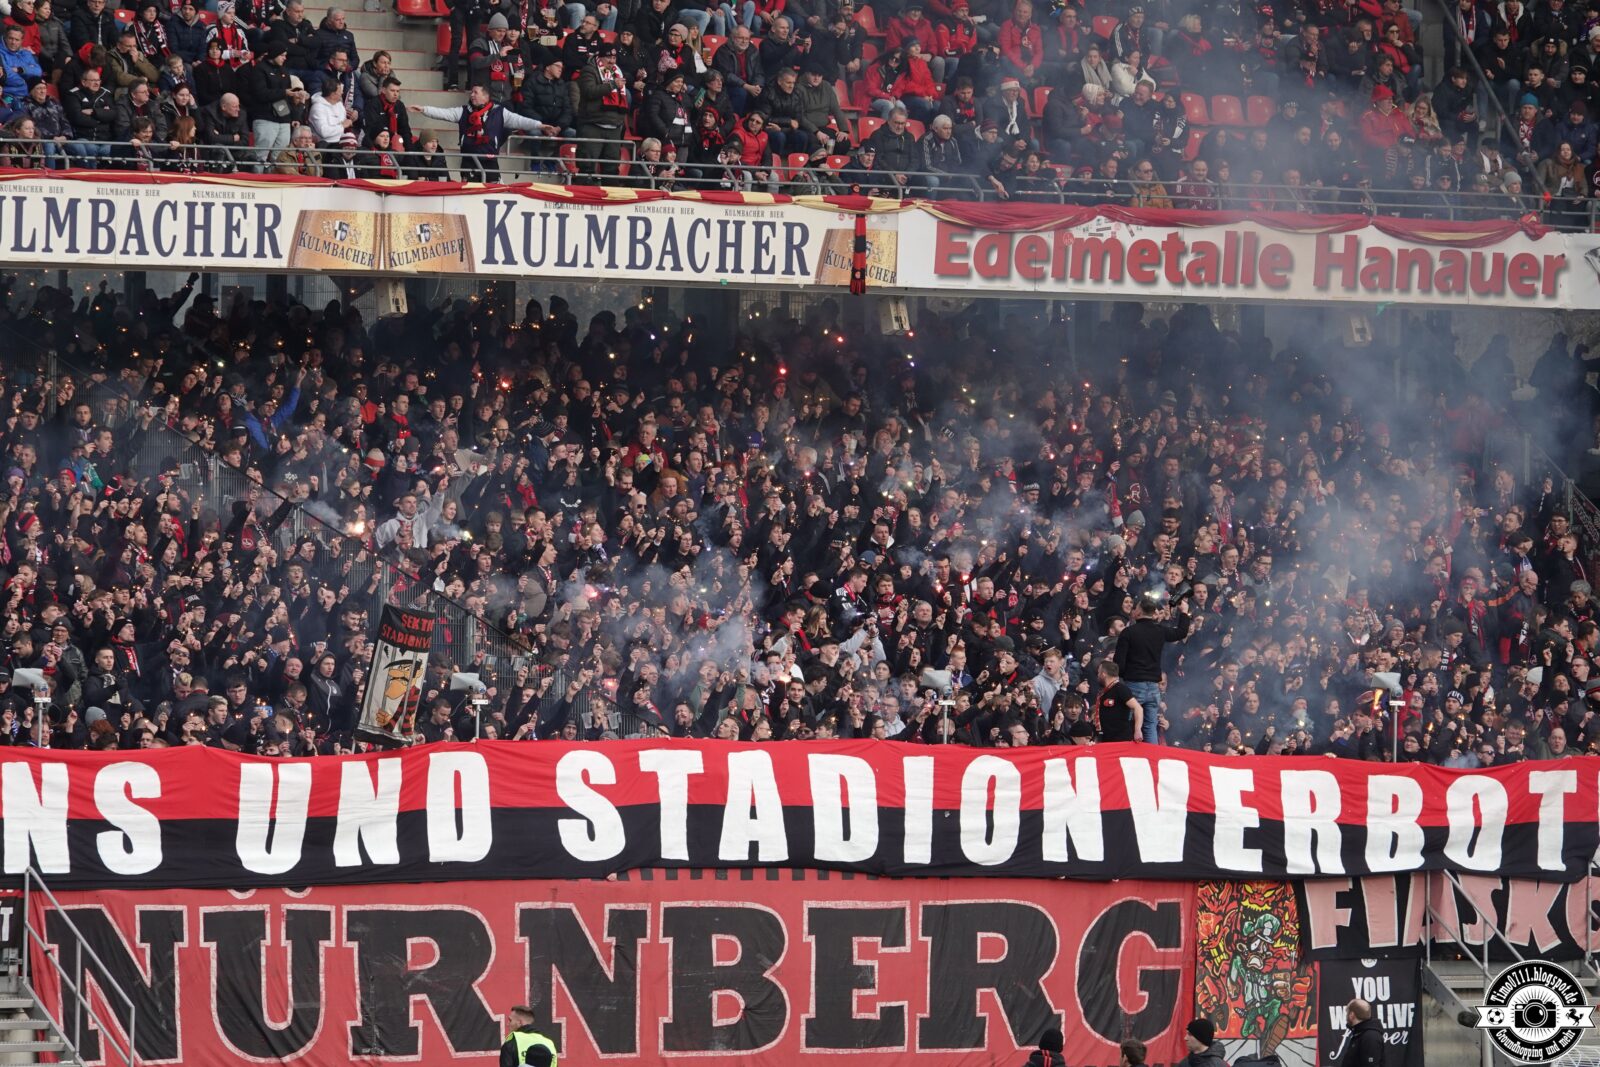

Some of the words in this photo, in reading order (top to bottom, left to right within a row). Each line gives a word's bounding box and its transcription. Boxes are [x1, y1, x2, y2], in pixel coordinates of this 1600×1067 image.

[0, 184, 43, 194] KULMBACHER
[49, 186, 64, 194] BIER
[97, 187, 140, 197] KULMBACHER
[145, 189, 161, 197] BIER
[192, 190, 236, 199] KULMBACHER
[240, 192, 256, 200] BIER
[0, 195, 283, 259] LMBACHER
[634, 205, 675, 214] KULMBACHER
[680, 207, 695, 215] BIER
[724, 208, 765, 219] KULMBACHER
[770, 210, 784, 218] BIER
[298, 231, 375, 268] KULMBACHER
[481, 199, 811, 277] KULMBACHER
[934, 219, 1293, 289] Edelmetalle
[1313, 234, 1566, 298] Hanauer
[235, 751, 493, 875] UND
[555, 749, 1600, 875] STADIONVERBOT
[46, 887, 1186, 1066] NÜRNBERG
[1351, 975, 1391, 1003] YOU
